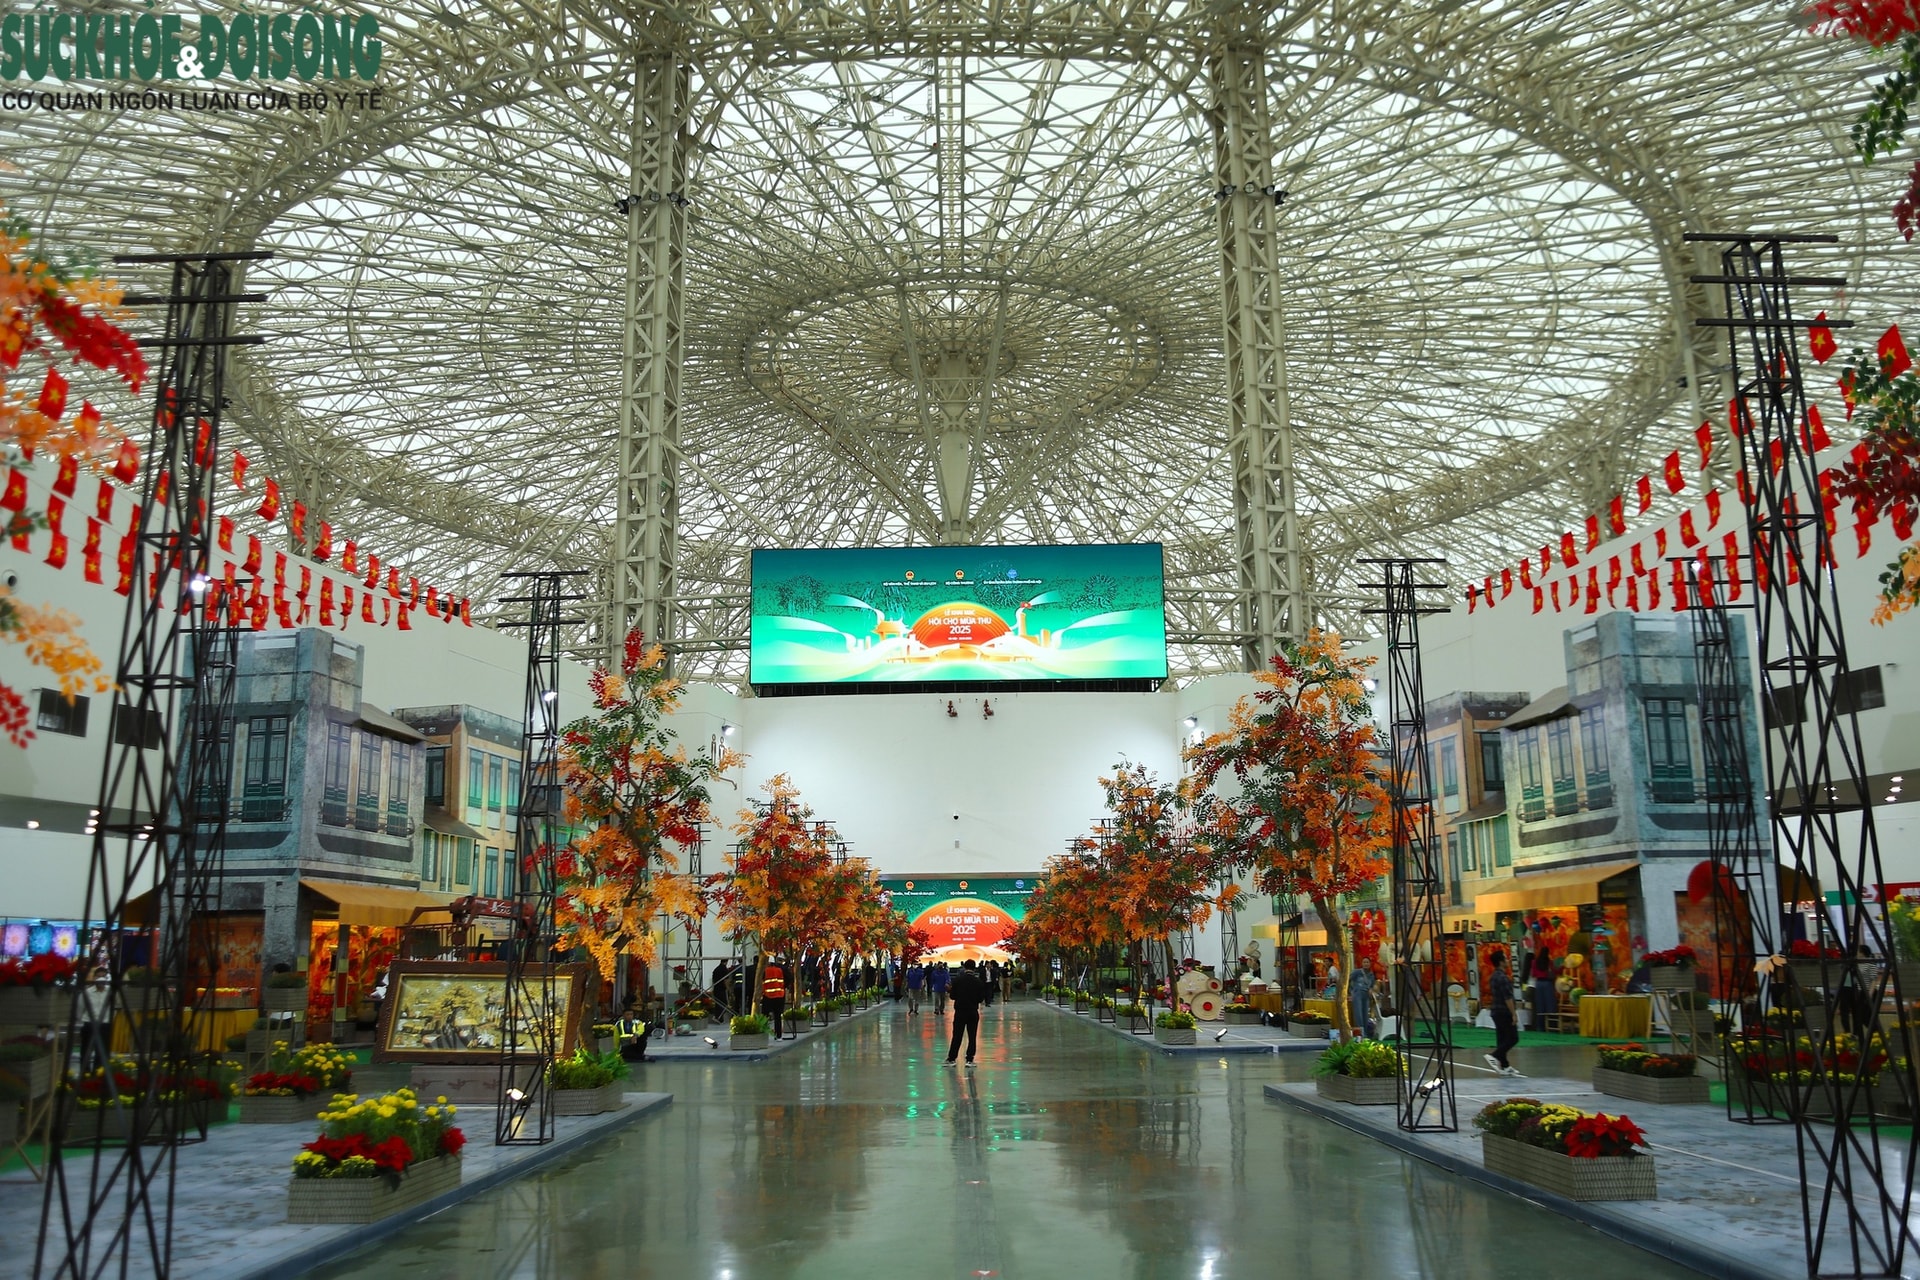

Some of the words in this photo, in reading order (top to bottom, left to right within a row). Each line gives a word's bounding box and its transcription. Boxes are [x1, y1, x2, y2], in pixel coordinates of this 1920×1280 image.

[978, 617, 992, 625] THU
[949, 625, 971, 634] 2025
[929, 915, 943, 925] HỘI
[945, 916, 962, 925] CHỢ
[983, 916, 999, 924] THU
[952, 925, 976, 935] 2025
